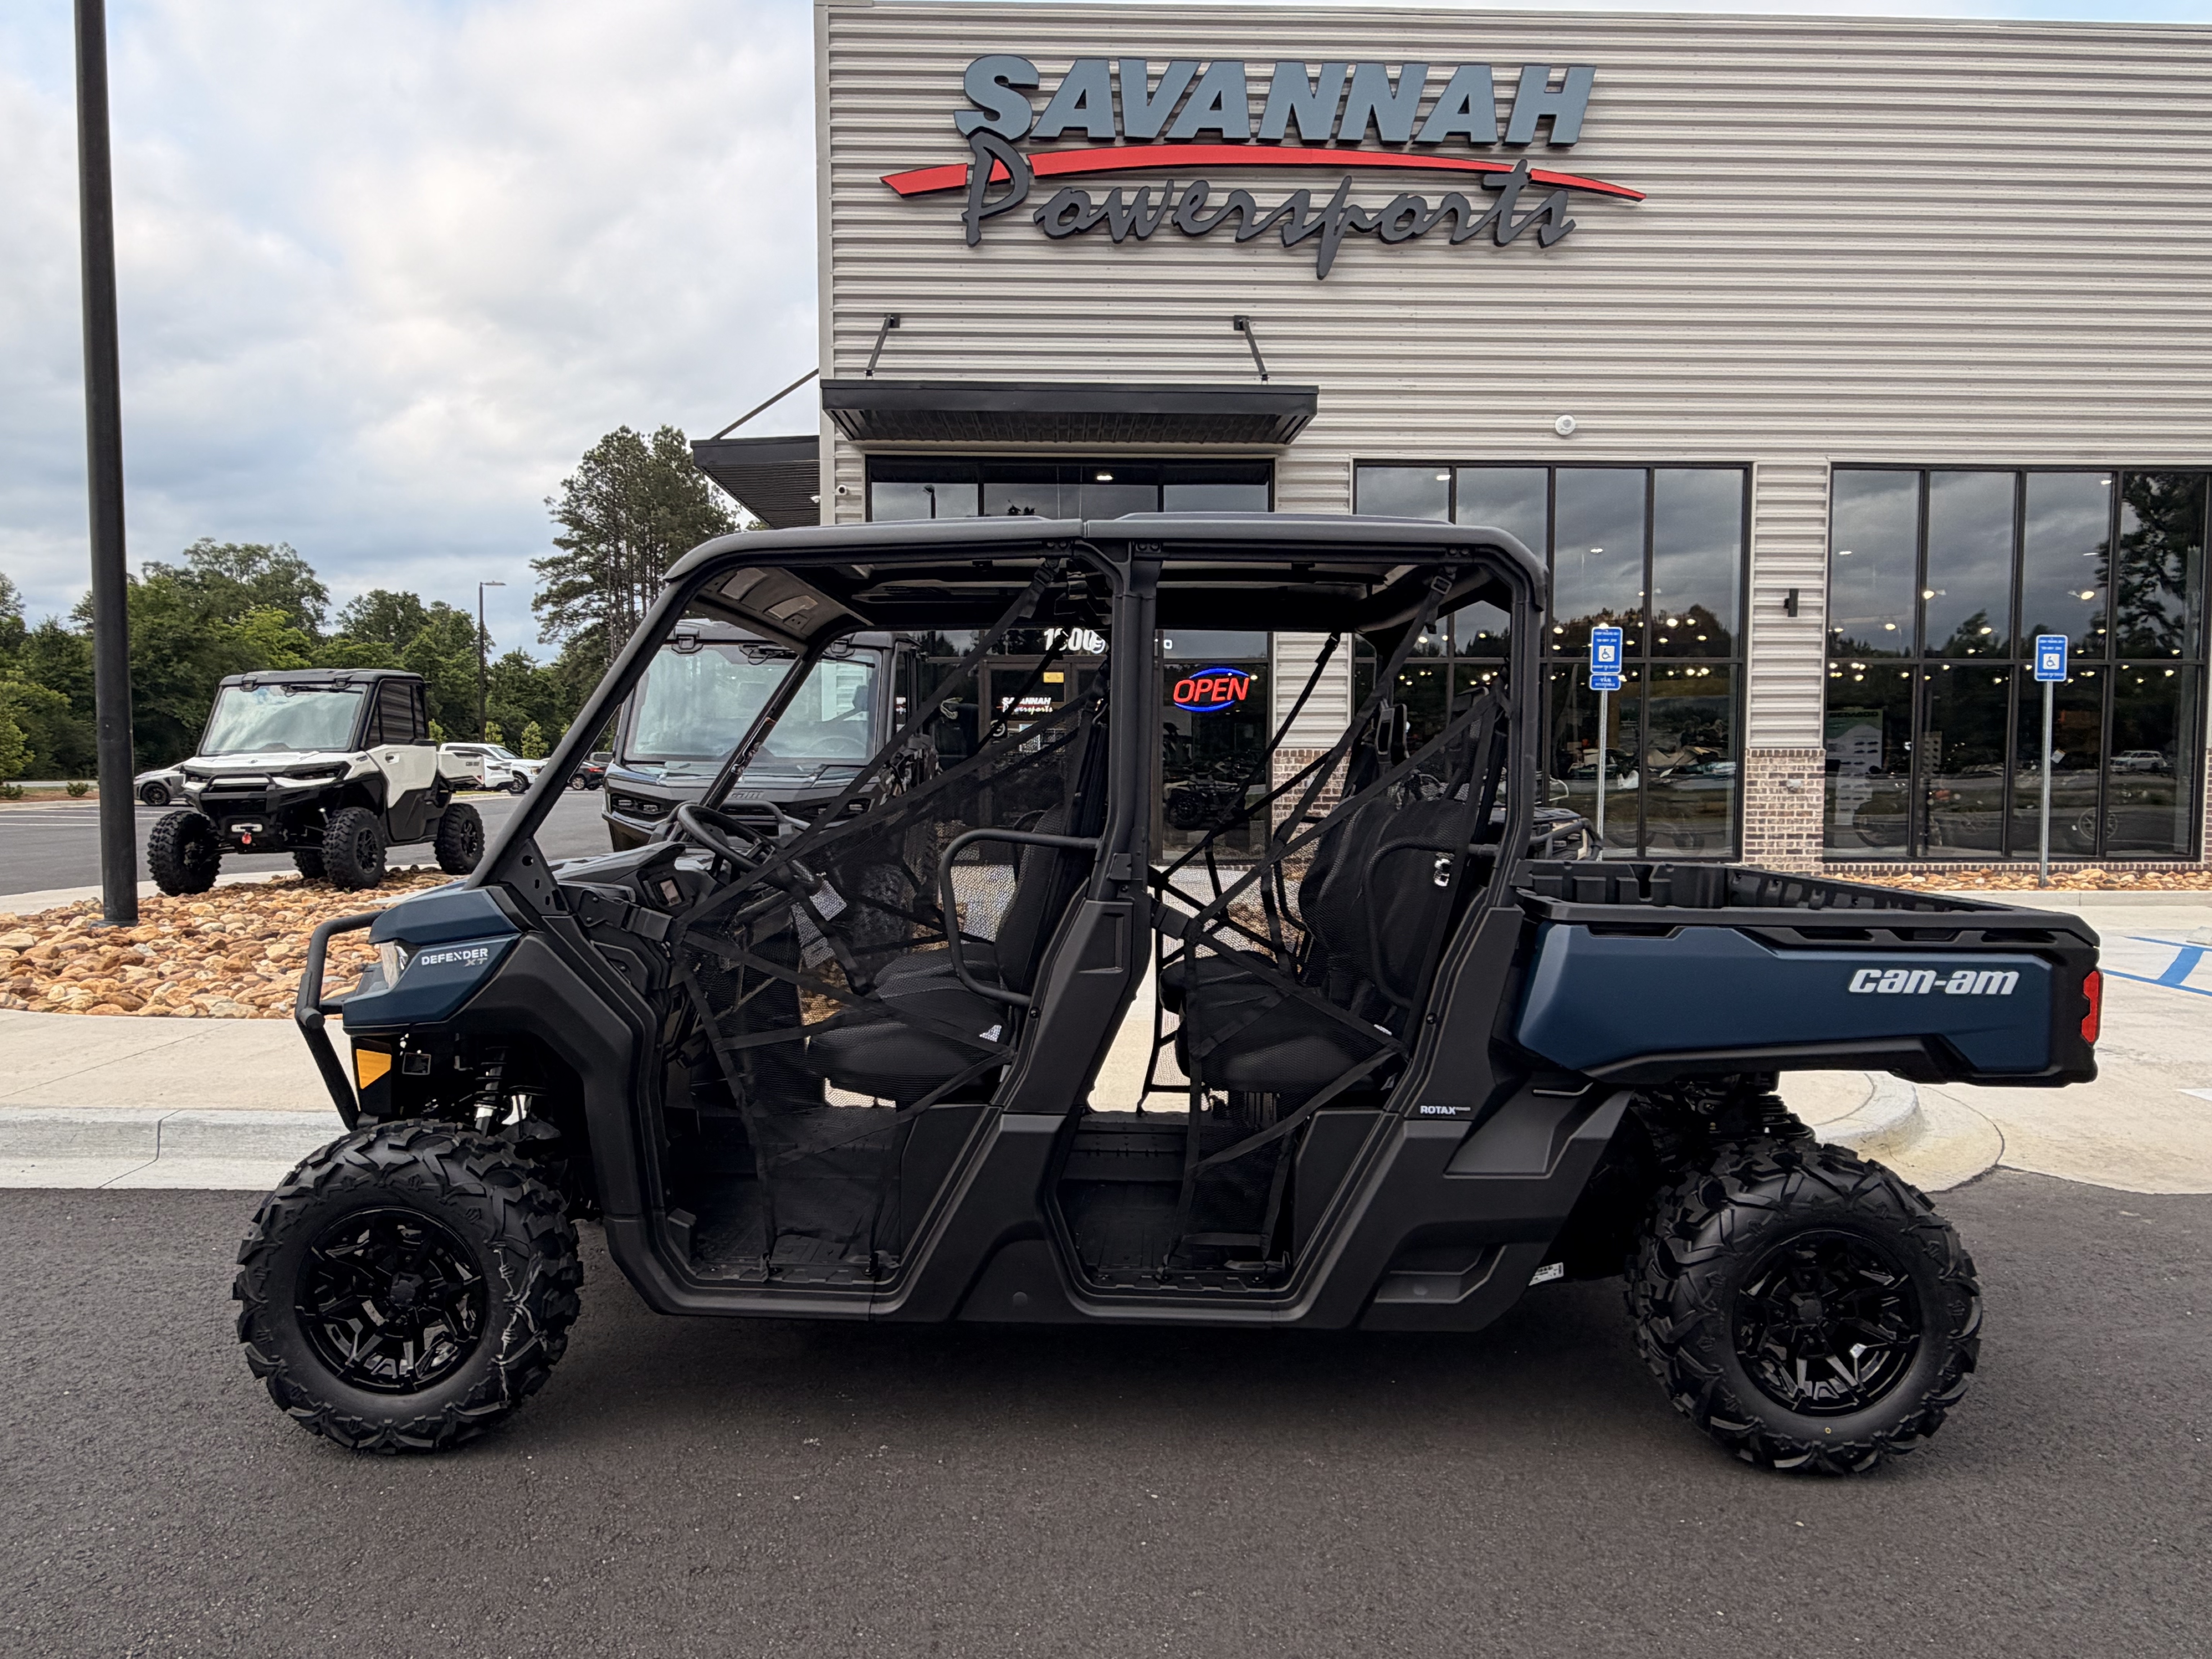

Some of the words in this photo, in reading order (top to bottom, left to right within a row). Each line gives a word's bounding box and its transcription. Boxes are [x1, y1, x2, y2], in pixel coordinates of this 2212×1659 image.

[953, 54, 1597, 145] SAVANNAH
[962, 127, 1577, 279] Powersports
[1173, 678, 1249, 702] OPEN
[421, 948, 488, 966] DEFENDER
[464, 957, 488, 967] XT
[1848, 969, 2019, 994] can-am
[1420, 1105, 1456, 1115] ROTAX
